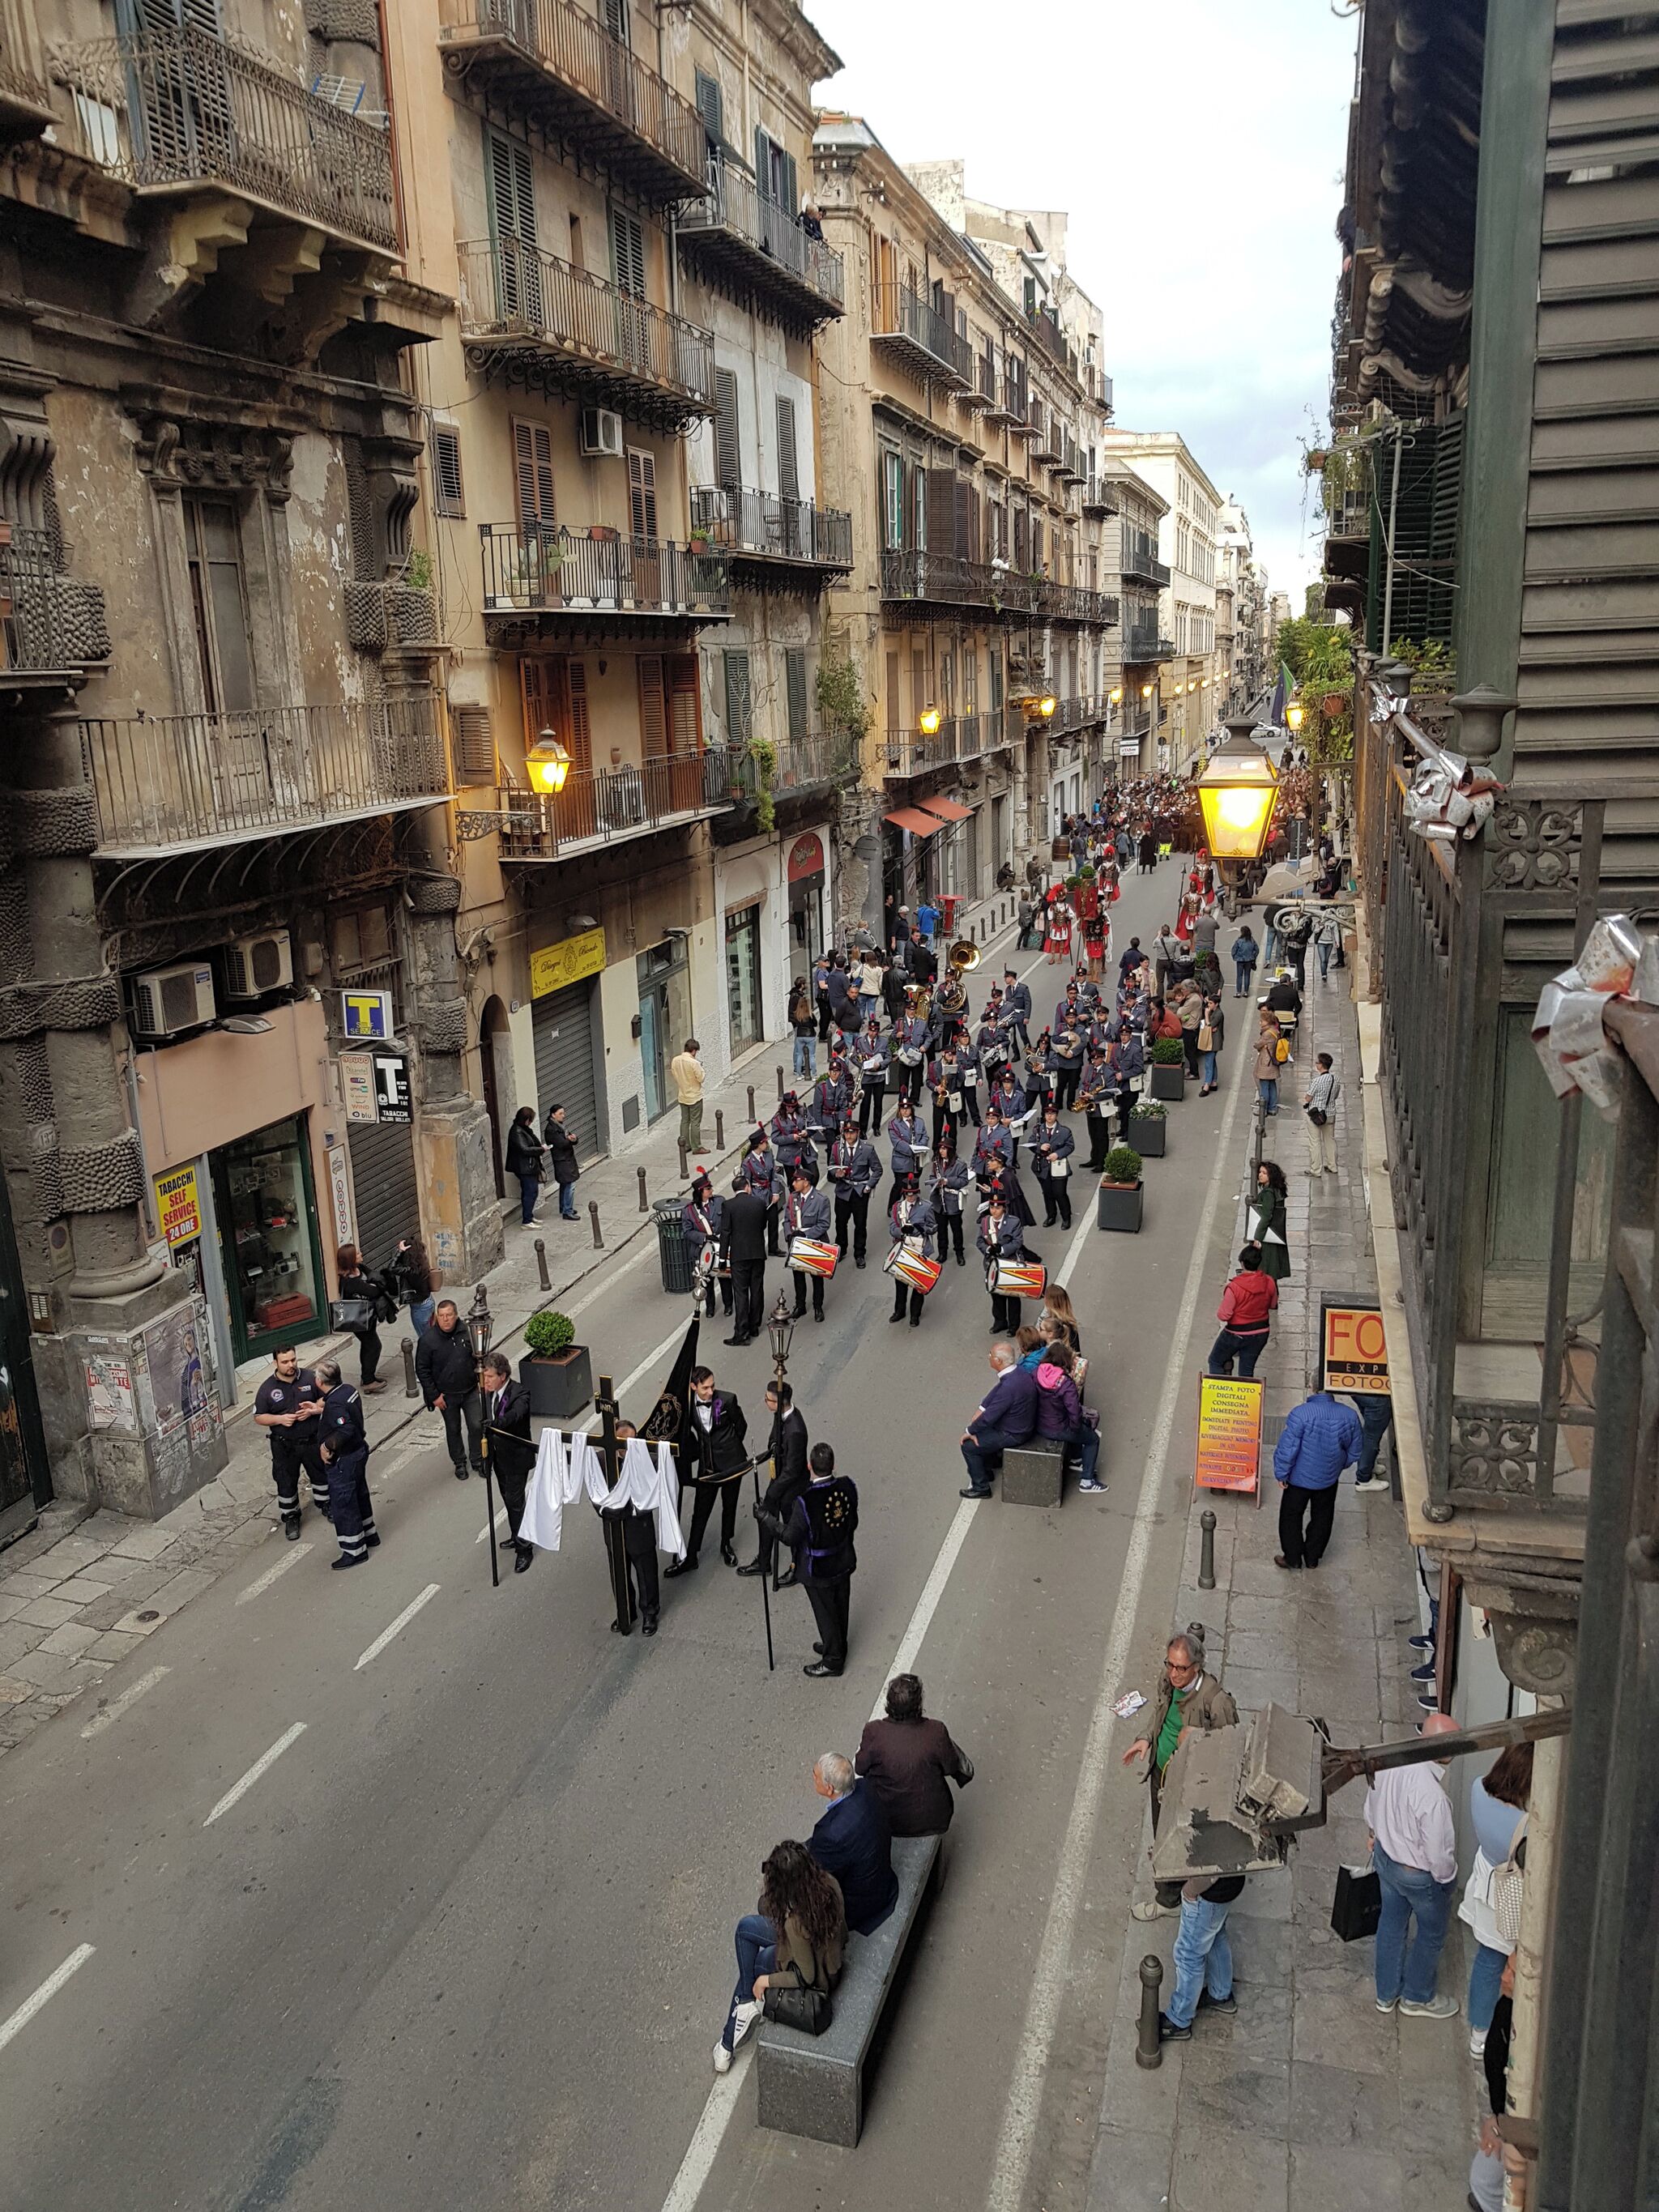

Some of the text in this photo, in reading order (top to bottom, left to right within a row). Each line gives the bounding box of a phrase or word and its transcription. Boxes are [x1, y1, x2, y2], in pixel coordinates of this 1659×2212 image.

[376, 1058, 403, 1104] T
[158, 1170, 194, 1197] TABACCHI
[168, 1188, 186, 1208] SELF
[336, 1180, 348, 1234] LOTTO
[163, 1200, 196, 1226] SERVICE
[169, 1218, 195, 1241] 24 ORE
[1212, 1400, 1249, 1408] CONSEGNA
[1217, 1392, 1246, 1400] DIGITALI
